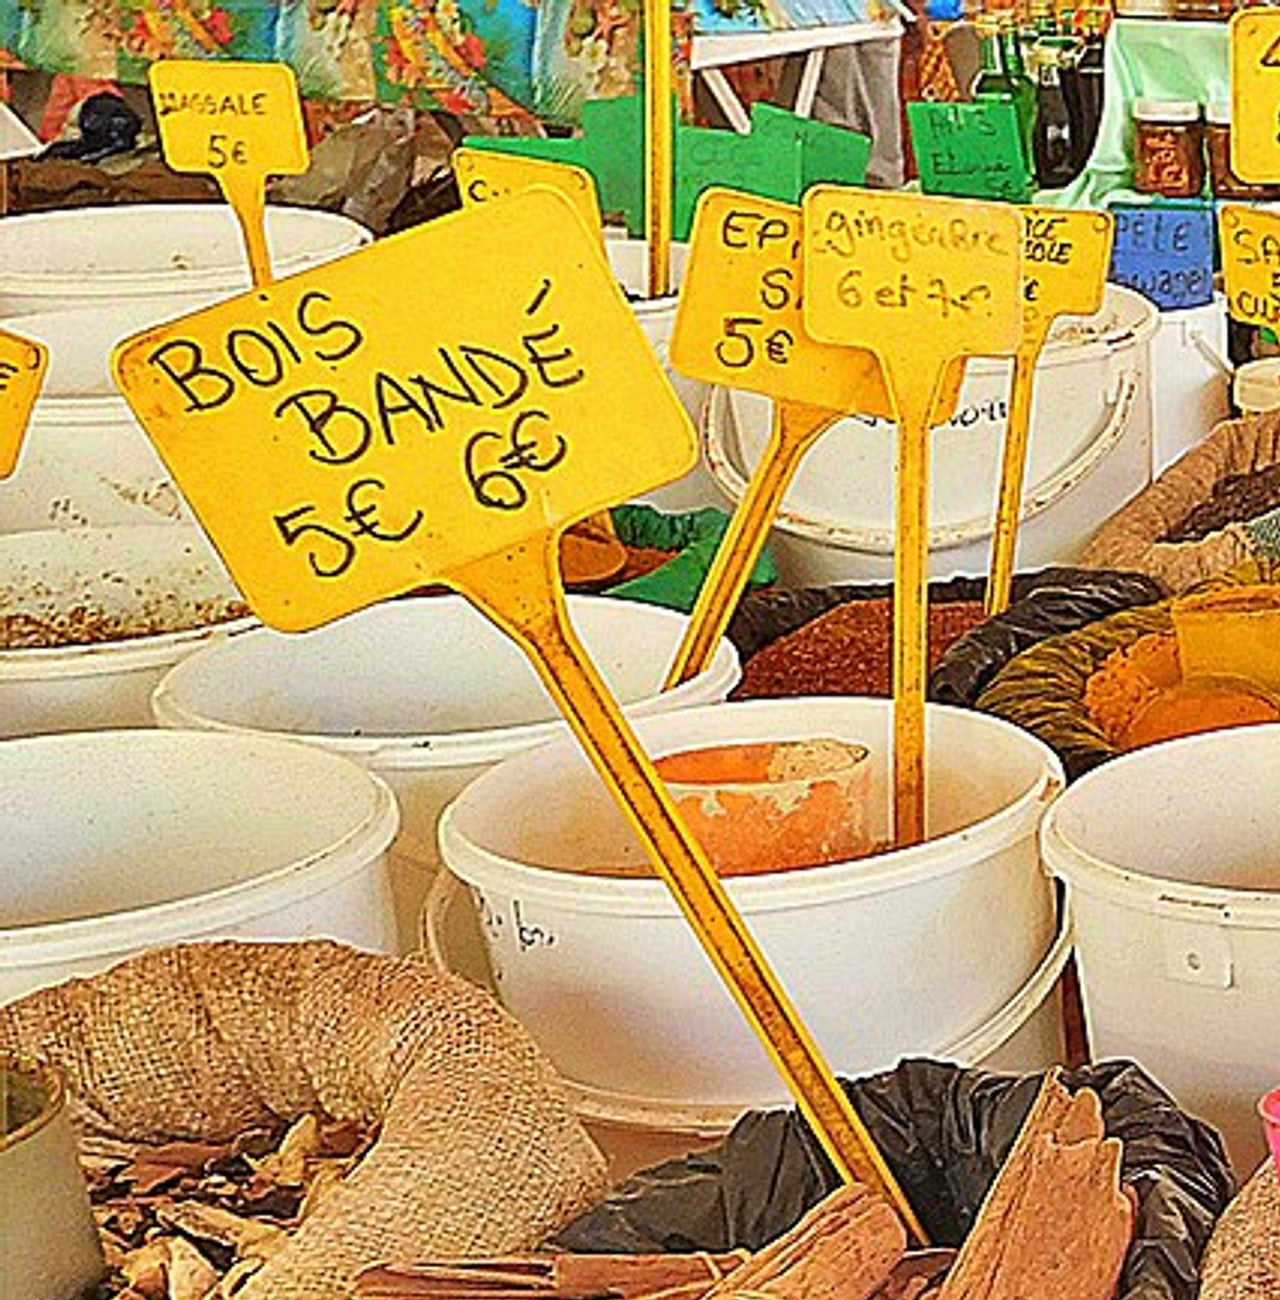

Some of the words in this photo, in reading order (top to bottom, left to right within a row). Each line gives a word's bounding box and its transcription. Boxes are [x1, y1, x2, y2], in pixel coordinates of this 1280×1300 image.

[207, 133, 249, 169] 5€
[147, 291, 364, 413] BOIS
[274, 278, 585, 466] BANDÉ
[714, 316, 794, 368] 5€
[273, 478, 424, 578] 5€
[463, 409, 568, 512] 6€
